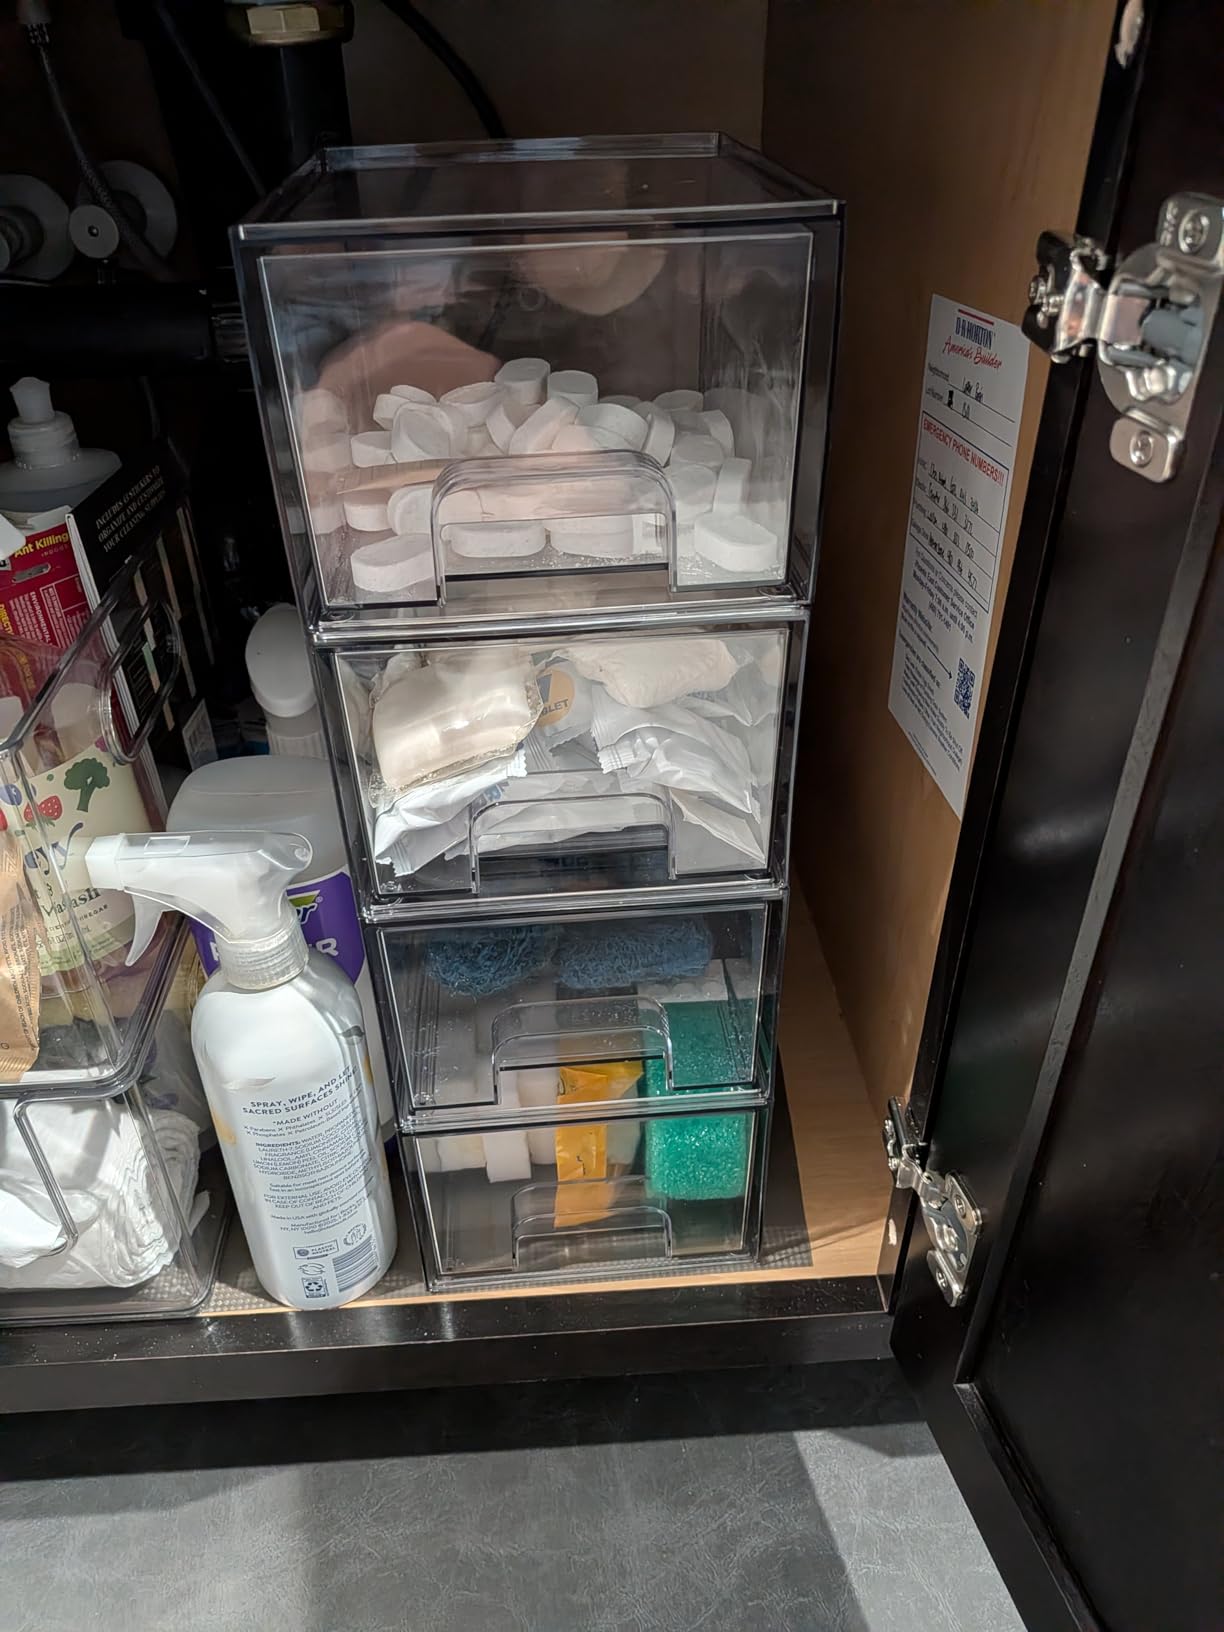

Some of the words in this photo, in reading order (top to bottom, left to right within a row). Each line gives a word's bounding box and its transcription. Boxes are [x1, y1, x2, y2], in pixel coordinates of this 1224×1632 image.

[973, 346, 1002, 370] Builder
[923, 417, 953, 449] EMERGENCY
[952, 439, 970, 462] PHONE
[14, 543, 34, 558] Ant
[35, 532, 70, 550] Killing
[540, 698, 569, 718] BLET
[284, 1088, 333, 1112] SURFACES
[334, 1065, 357, 1090] SHINE
[288, 1091, 316, 1103] WIPE,
[318, 1078, 336, 1093] AND
[338, 1065, 349, 1079] LET
[302, 1098, 337, 1119] WITHOUT
